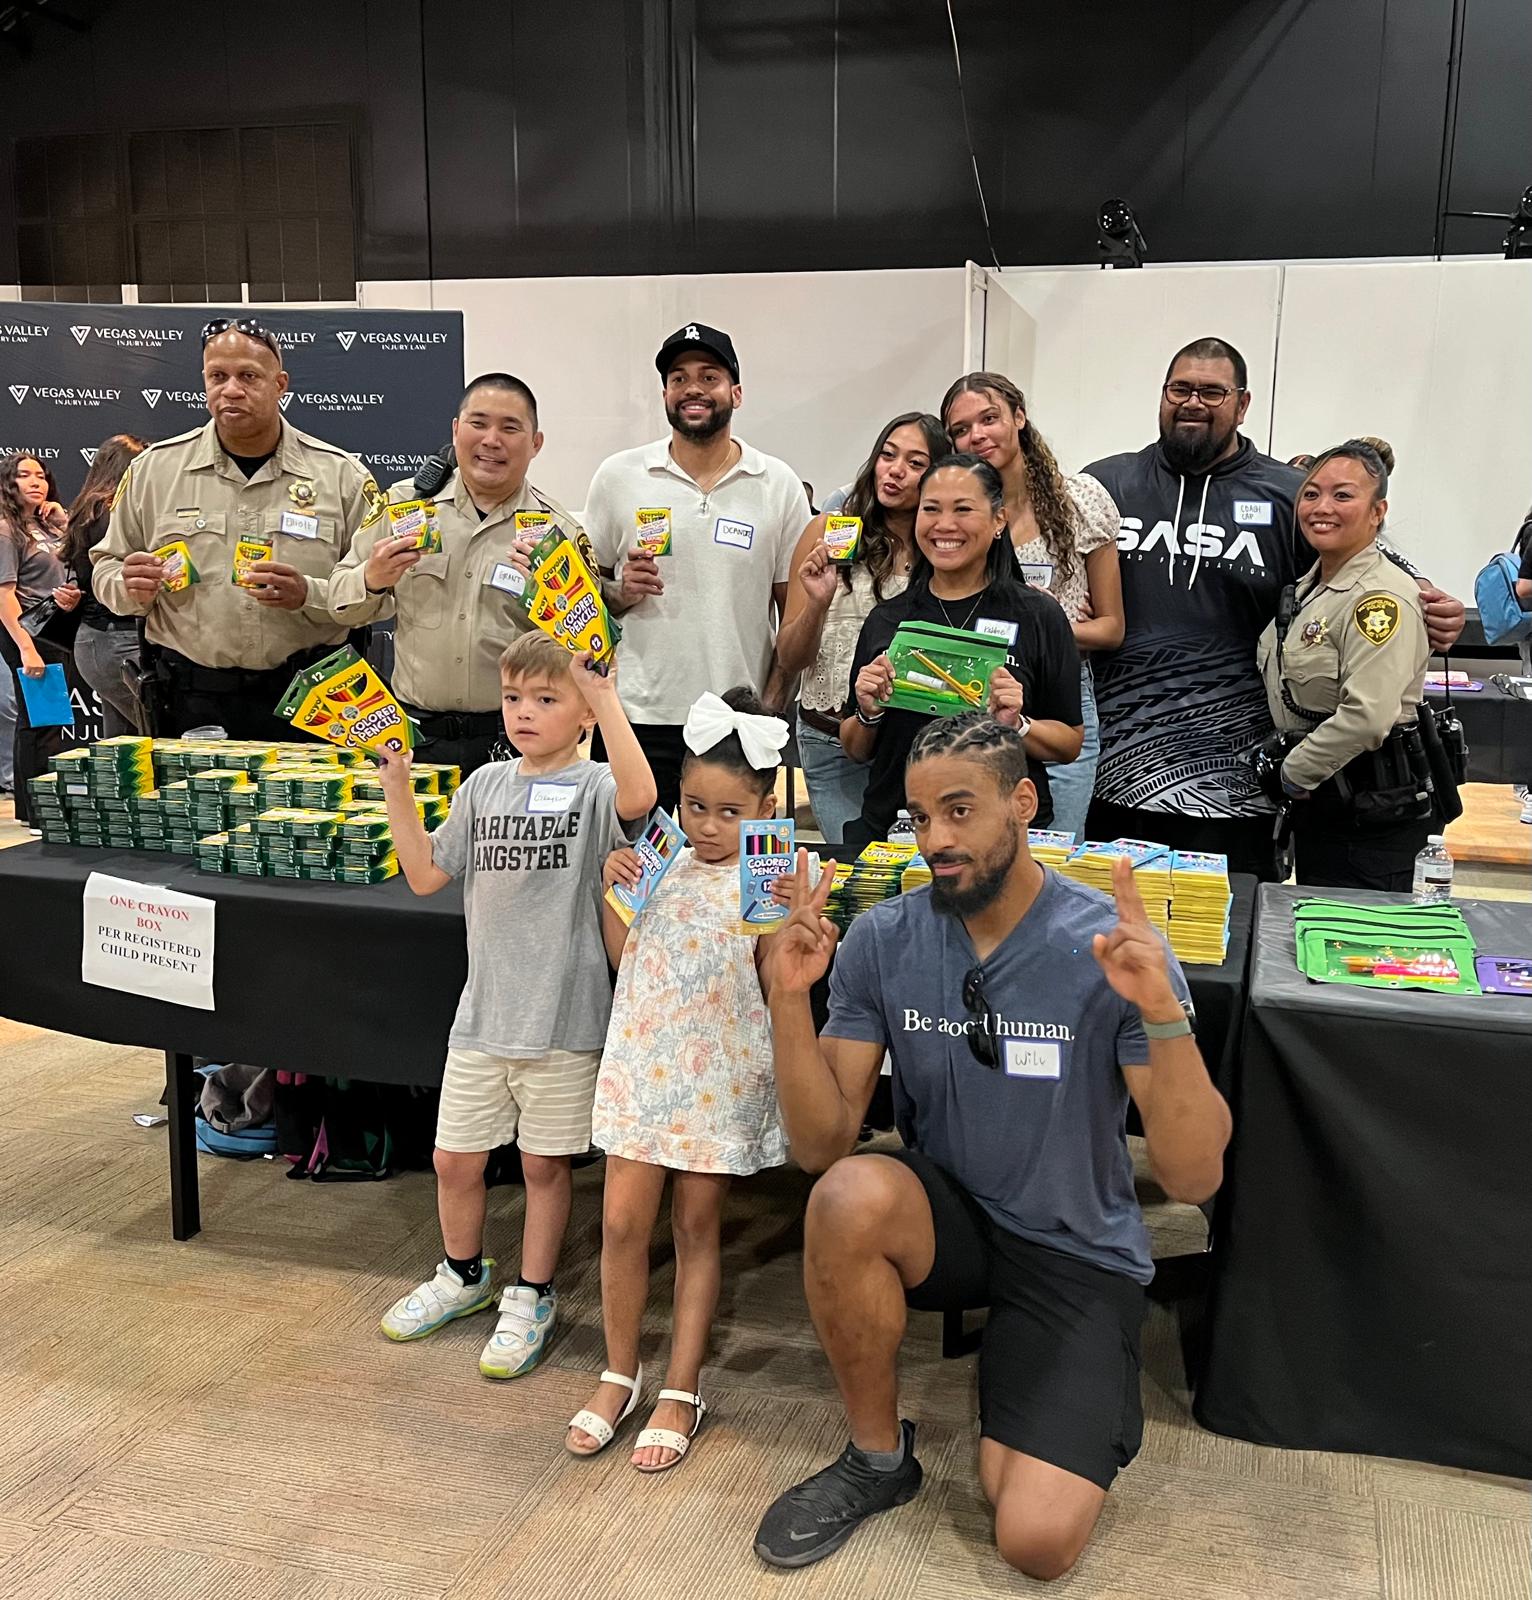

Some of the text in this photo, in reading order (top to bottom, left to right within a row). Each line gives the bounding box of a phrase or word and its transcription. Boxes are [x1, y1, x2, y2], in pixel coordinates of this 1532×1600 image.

[4, 325, 50, 336] VALLEY
[95, 328, 184, 341] VEGAS VALLEY
[117, 339, 144, 347] INJURY
[360, 332, 448, 344] VEGAS VALLEY
[33, 387, 121, 400] VEGAS VALLEY
[297, 393, 385, 405] VEGAS VALLEY
[366, 454, 406, 465] VEGAS
[543, 555, 565, 580] Crayola
[563, 592, 594, 629] COLORED
[569, 605, 598, 638] PENCILS
[591, 637, 601, 649] 12
[311, 671, 325, 682] 12
[326, 672, 362, 694] Crayola
[282, 706, 296, 717] 12
[350, 704, 396, 735] COLORED
[357, 713, 401, 742] PENCILS
[386, 740, 401, 751] 12
[475, 843, 567, 872] ANGSTER
[639, 841, 662, 871] COLORED
[747, 858, 791, 869] COLORED
[110, 895, 190, 921] ONE CRAYON
[137, 917, 162, 931] BOX
[98, 926, 201, 958] PER REGISTERED
[101, 943, 197, 973] CHILD PRESENT
[903, 1009, 932, 1031] Be
[996, 1013, 1075, 1041] human.
